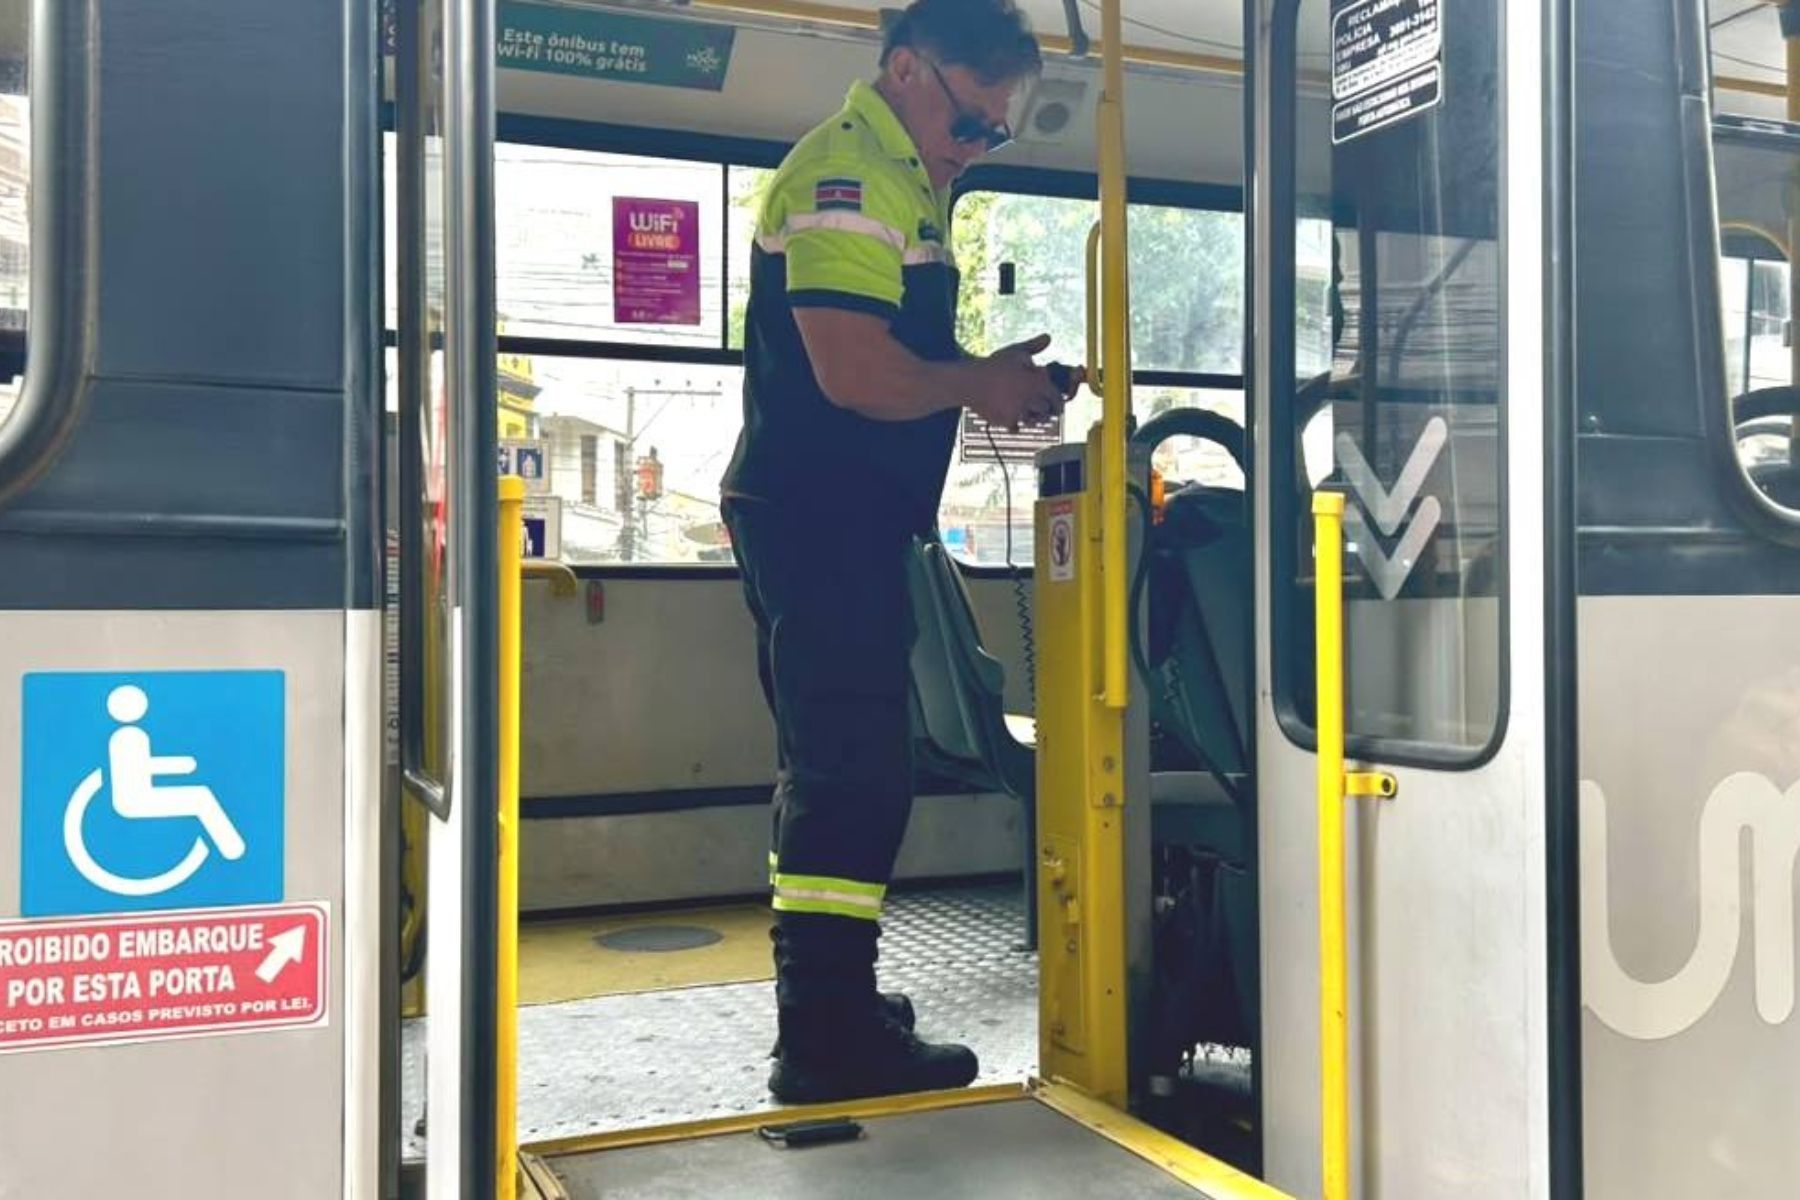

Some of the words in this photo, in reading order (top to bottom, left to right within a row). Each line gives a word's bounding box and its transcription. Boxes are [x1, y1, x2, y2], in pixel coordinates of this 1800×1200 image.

[503, 28, 544, 45] Este
[611, 40, 645, 58] tem
[546, 49, 593, 67] 100%
[595, 54, 647, 73] grátis
[118, 923, 264, 959] EMBARQUE
[8, 975, 65, 1008] POR
[73, 971, 141, 1003] ESTA
[150, 965, 235, 997] PORTA
[48, 1015, 76, 1029] EM
[81, 1010, 143, 1027] CASOS
[150, 1001, 236, 1021] PREVISTO
[241, 998, 277, 1014] POR
